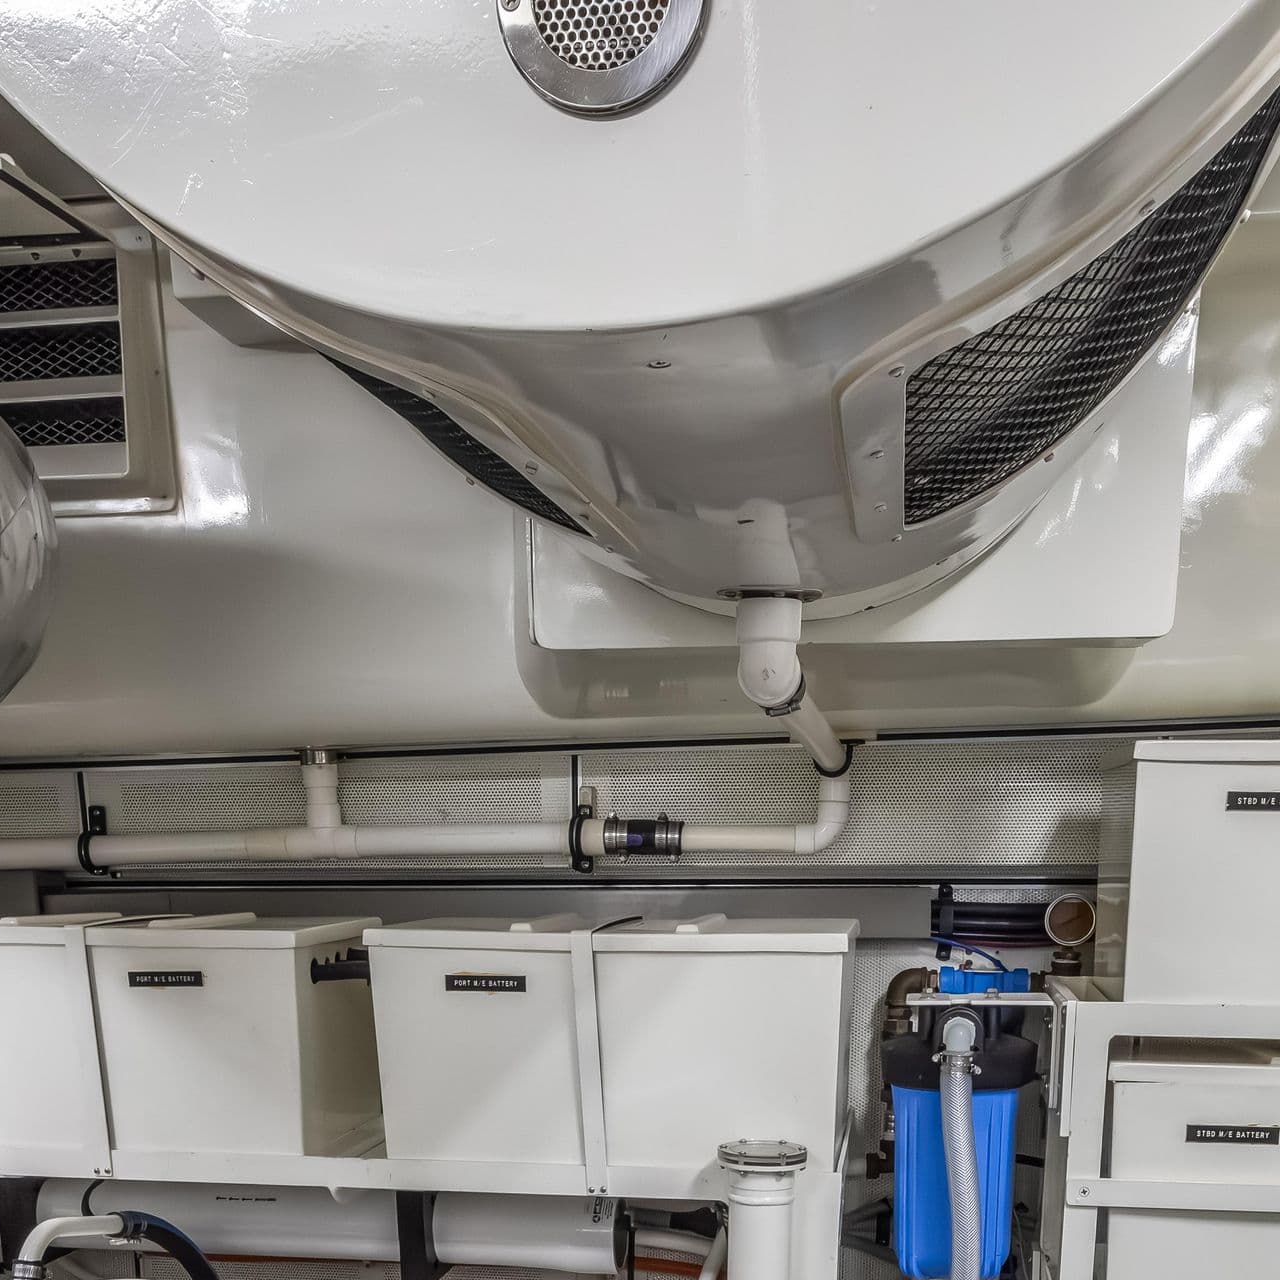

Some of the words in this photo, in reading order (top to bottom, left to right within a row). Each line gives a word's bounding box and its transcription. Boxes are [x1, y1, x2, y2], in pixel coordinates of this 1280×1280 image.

[1237, 797, 1258, 805] STBD
[1260, 797, 1276, 805] M/E
[473, 979, 486, 987] M/E
[488, 980, 518, 988] BATTERY
[1218, 1130, 1233, 1138] M/E
[1236, 1131, 1270, 1139] BATTERY
